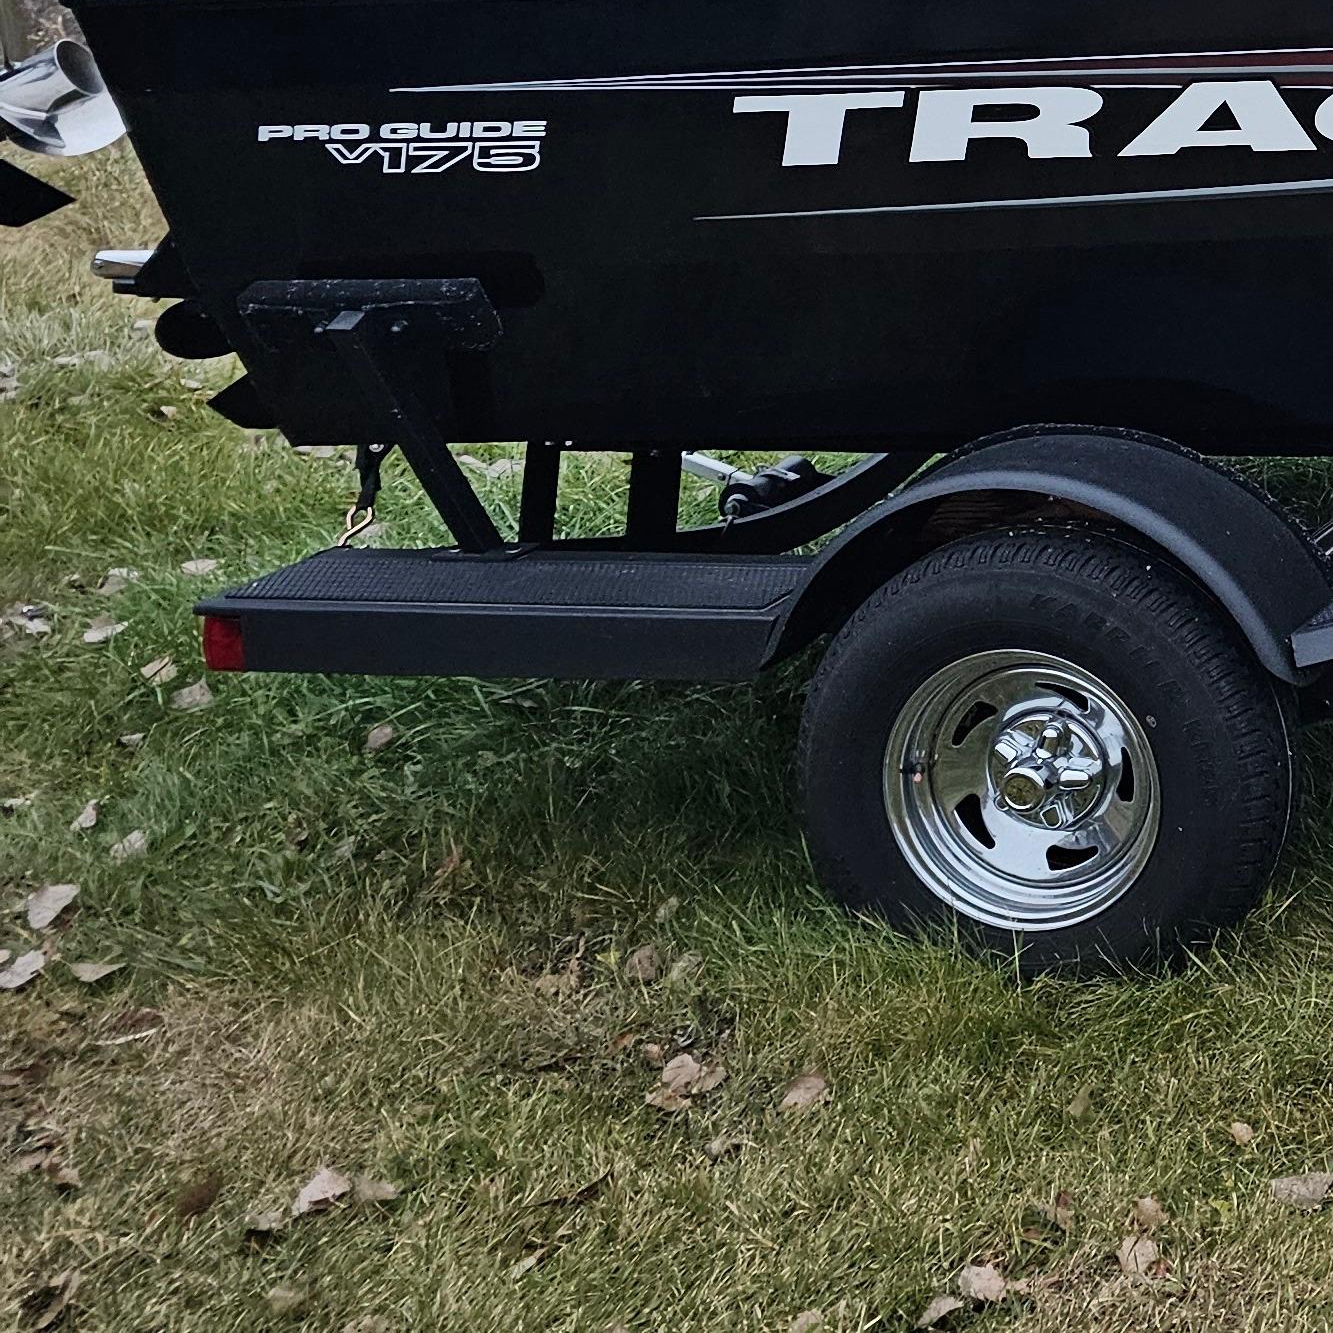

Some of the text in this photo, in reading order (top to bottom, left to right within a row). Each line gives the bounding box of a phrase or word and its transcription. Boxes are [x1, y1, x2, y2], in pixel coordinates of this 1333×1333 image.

[257, 120, 548, 141] PRO GUIDE
[324, 141, 541, 174] V175
